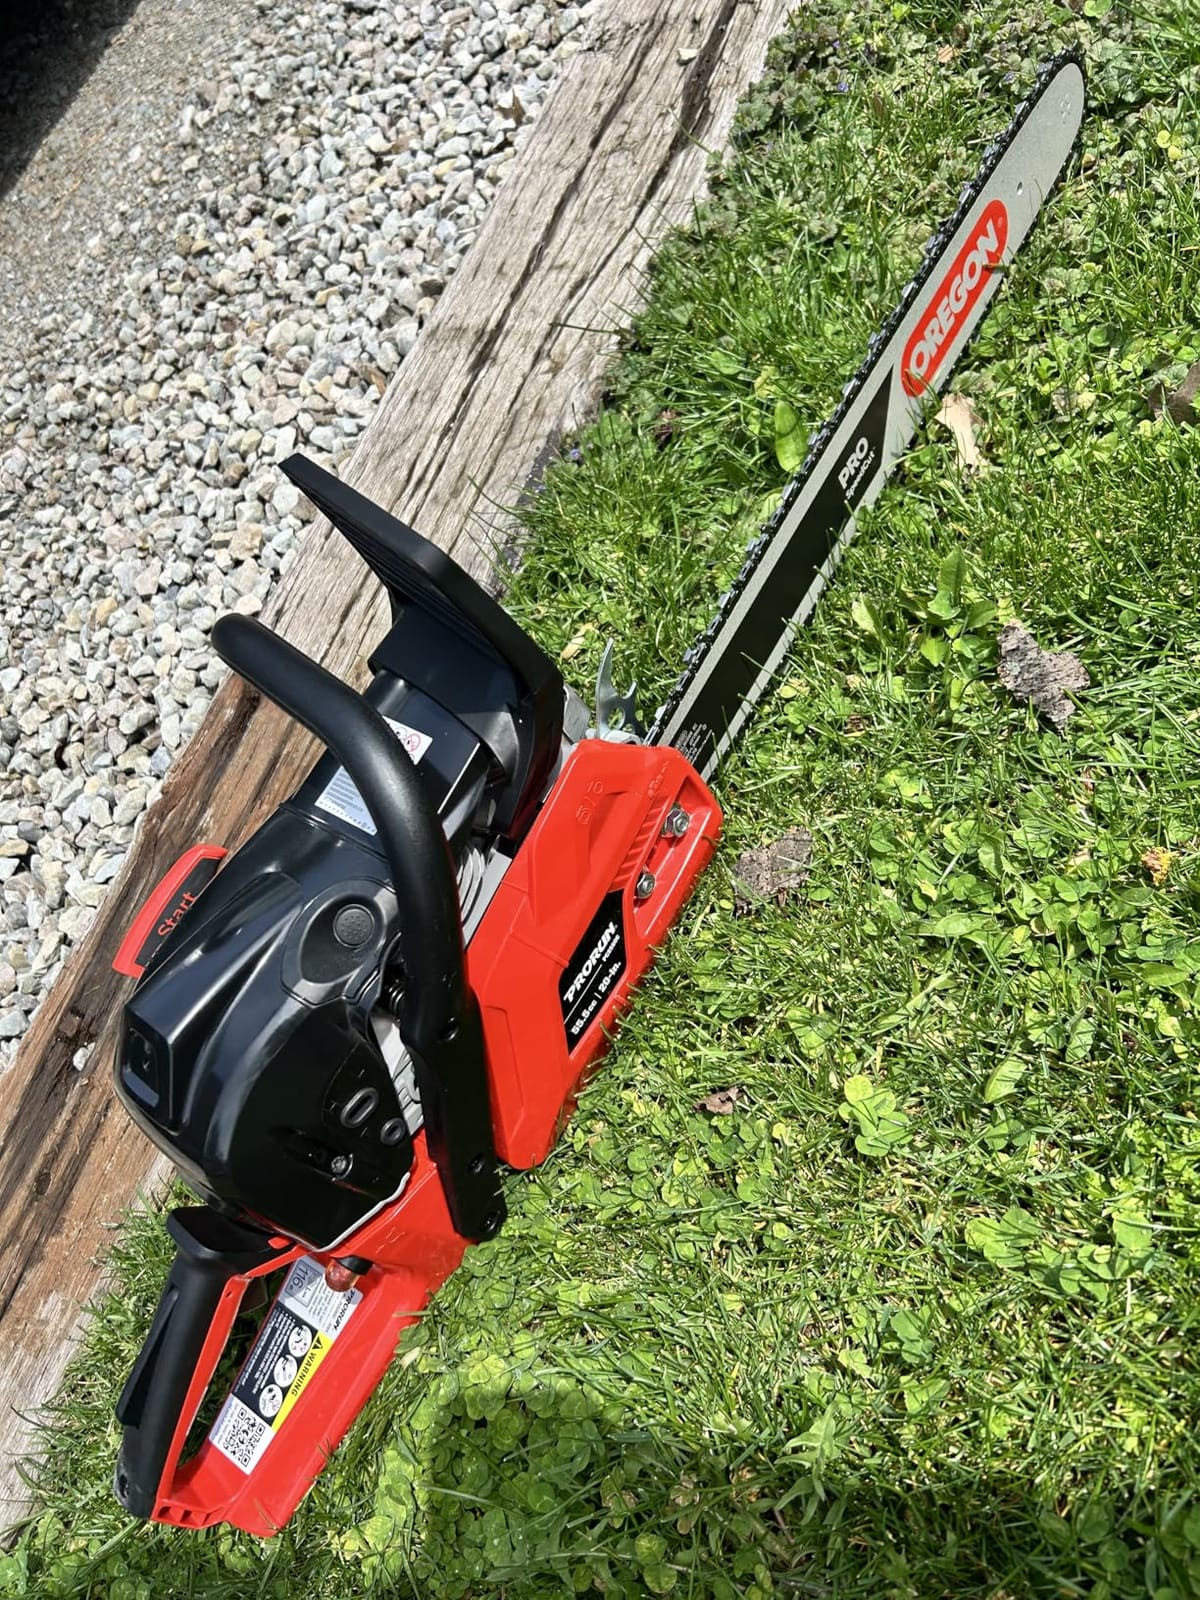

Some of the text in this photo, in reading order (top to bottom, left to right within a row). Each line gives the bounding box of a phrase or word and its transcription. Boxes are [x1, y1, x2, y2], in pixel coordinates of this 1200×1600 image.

[909, 218, 999, 377] OREGON
[838, 437, 868, 490] PRO
[845, 451, 875, 500] SpeedCut
[157, 892, 197, 936] Start
[563, 921, 617, 1003] PRORUN
[571, 961, 622, 1035] 55.5cc 20-in.
[292, 1266, 309, 1289] 116
[333, 1289, 356, 1331] PRORUN
[291, 1351, 317, 1397] WARNING
